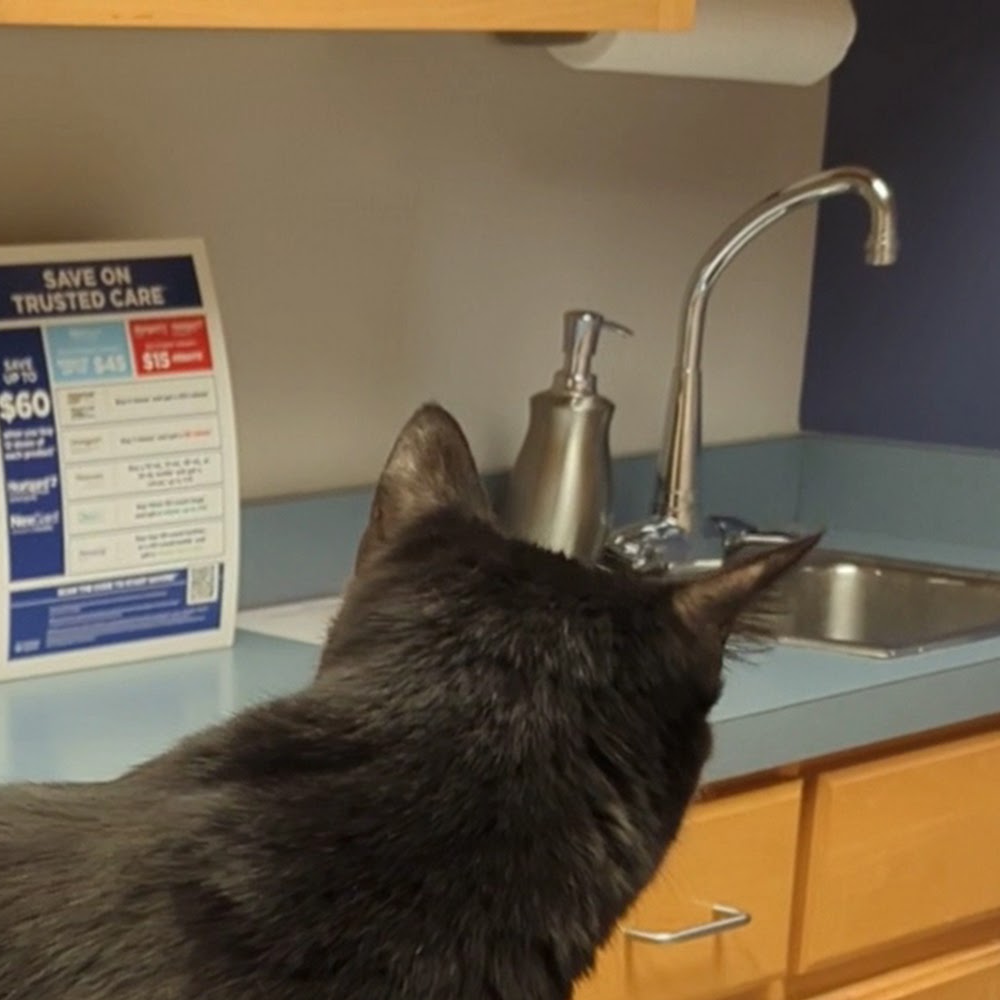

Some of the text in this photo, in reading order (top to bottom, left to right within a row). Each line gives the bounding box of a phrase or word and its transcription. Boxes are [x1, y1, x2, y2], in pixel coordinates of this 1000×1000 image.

[42, 265, 131, 289] SAVE ON
[10, 287, 165, 315] TRUSTED CARE
[3, 357, 34, 371] SAVE
[142, 351, 170, 371] $15
[3, 371, 38, 385] UP TO
